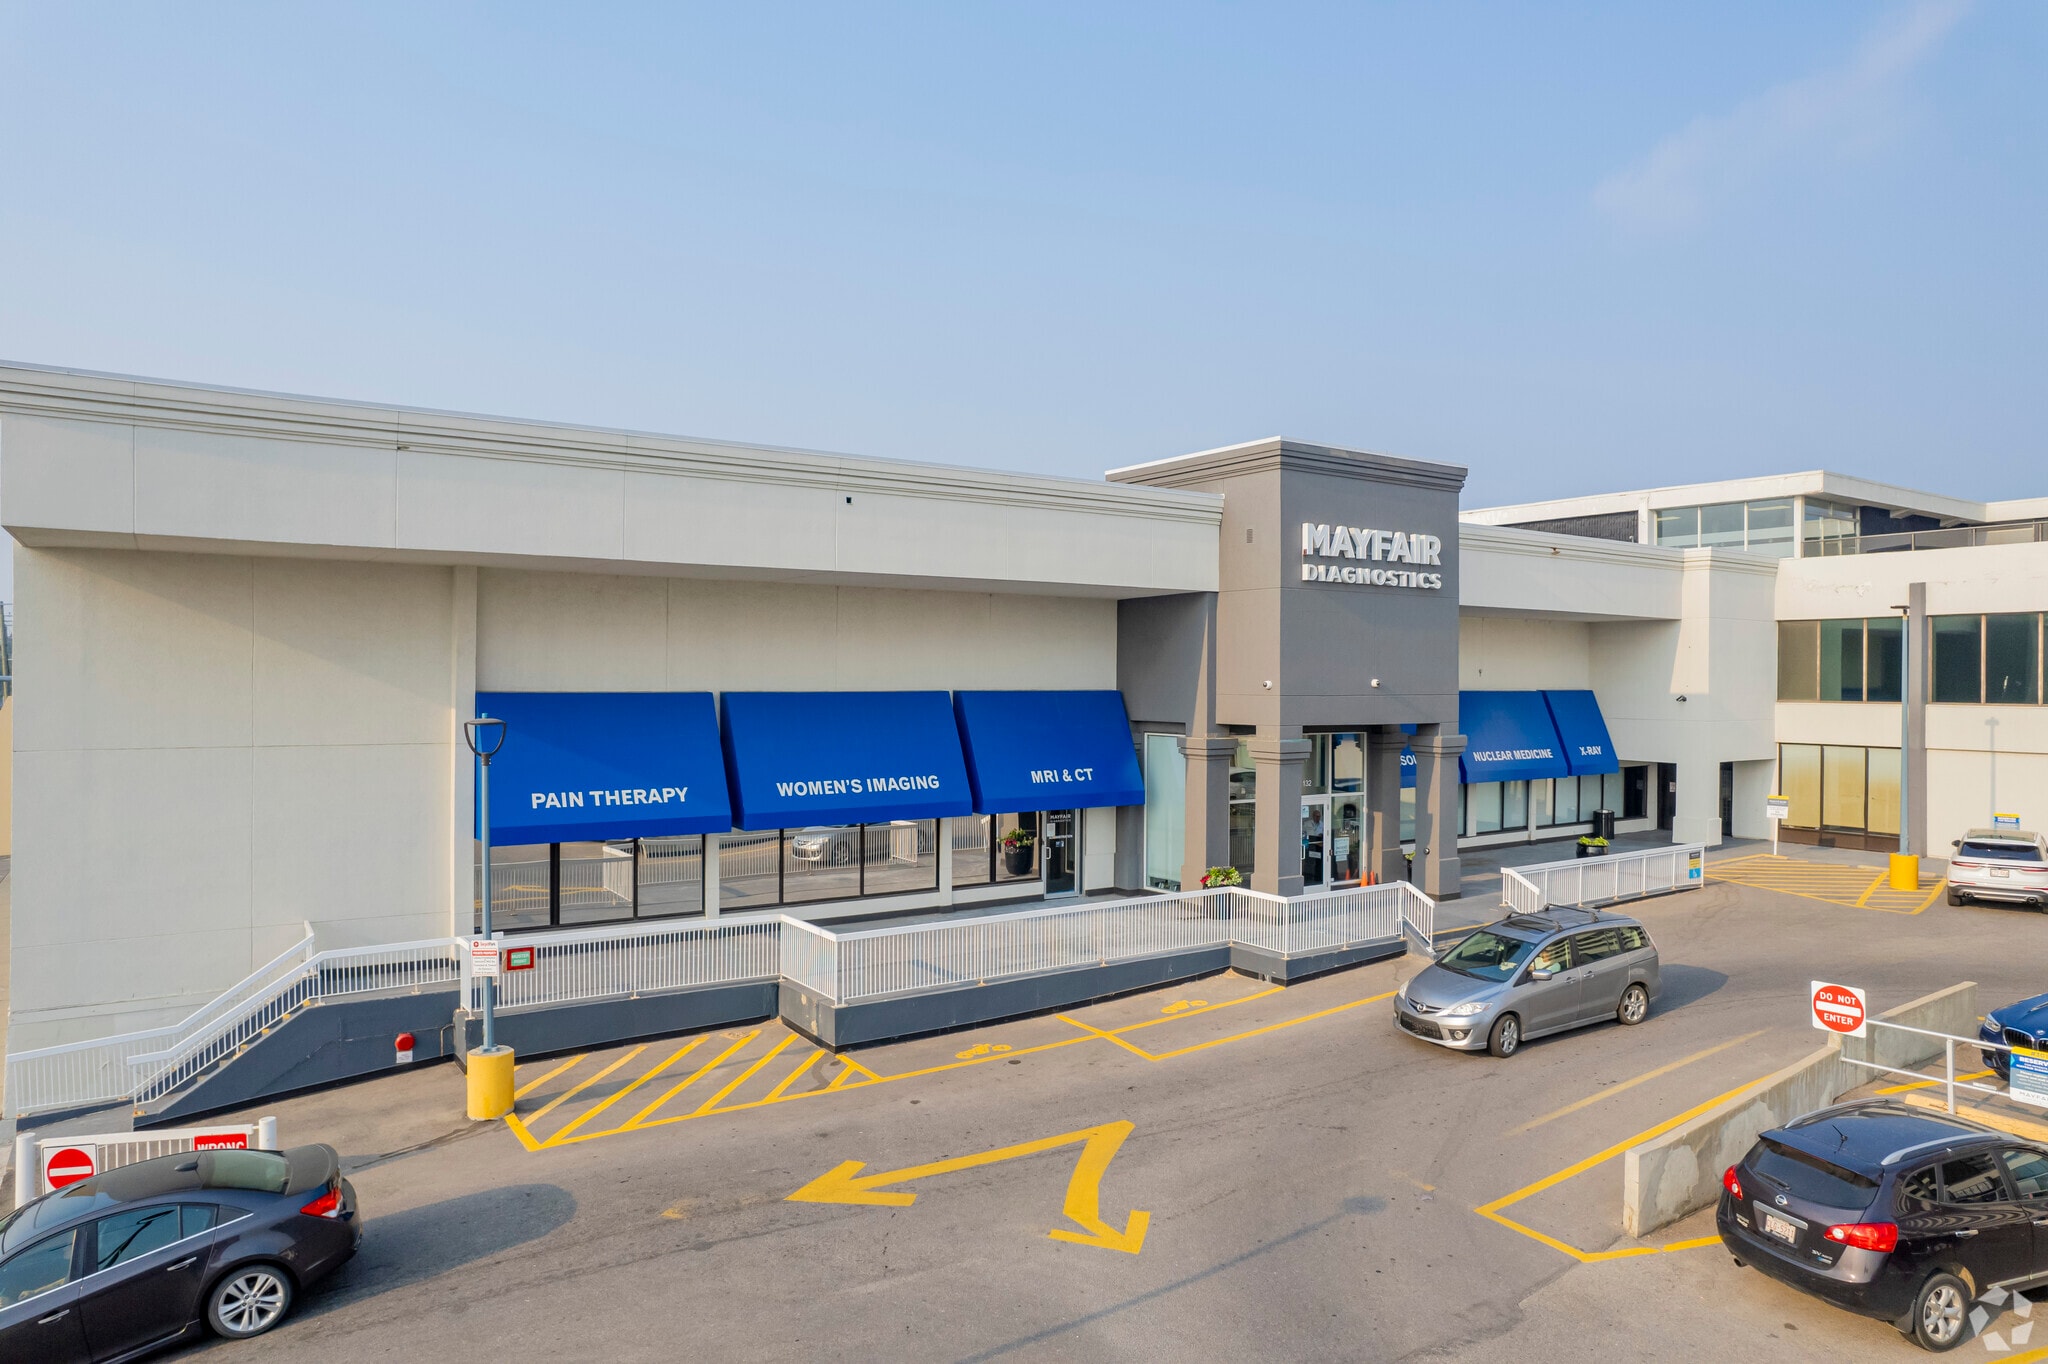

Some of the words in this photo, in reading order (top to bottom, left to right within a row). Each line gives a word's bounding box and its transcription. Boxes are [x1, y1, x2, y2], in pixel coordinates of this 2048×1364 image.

[1301, 522, 1441, 566] MAYFAIR
[1301, 563, 1442, 590] DIAGNOSTICS
[1472, 750, 1513, 762] NUCLEAR
[1513, 748, 1553, 760] MEDICINE
[1578, 746, 1602, 756] X-RAY
[1030, 769, 1060, 784] MRI
[1062, 769, 1073, 782] &
[1074, 767, 1093, 781] CT
[776, 779, 863, 797] WOMEN’S
[866, 775, 940, 793] IMAGING
[531, 791, 584, 809] PAIN
[589, 787, 688, 807] THERAPY
[1820, 991, 1833, 1001] DO
[1837, 994, 1856, 1006] NOT
[1823, 1012, 1854, 1026] ENTER
